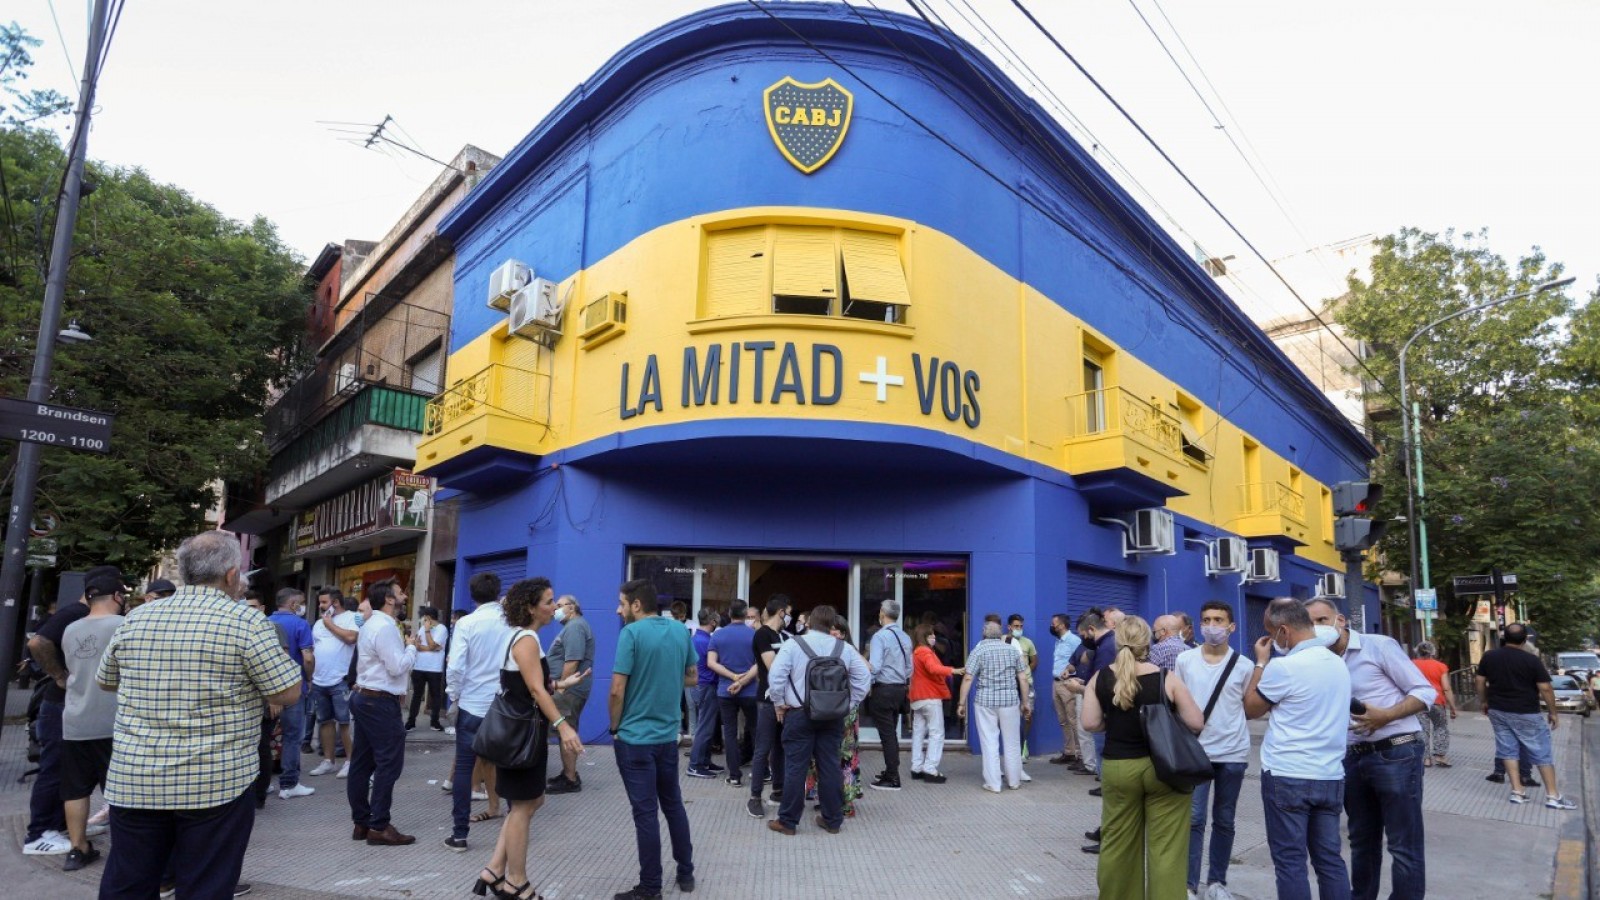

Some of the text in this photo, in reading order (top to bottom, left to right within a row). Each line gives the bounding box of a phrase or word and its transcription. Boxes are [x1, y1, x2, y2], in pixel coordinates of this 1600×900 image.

[775, 106, 842, 127] CABJ
[620, 354, 663, 420] LA
[681, 341, 842, 408] MITAD
[911, 352, 981, 429] VOS
[37, 405, 106, 425] Brandsen
[20, 429, 56, 442] 1200
[70, 436, 103, 449] 1100
